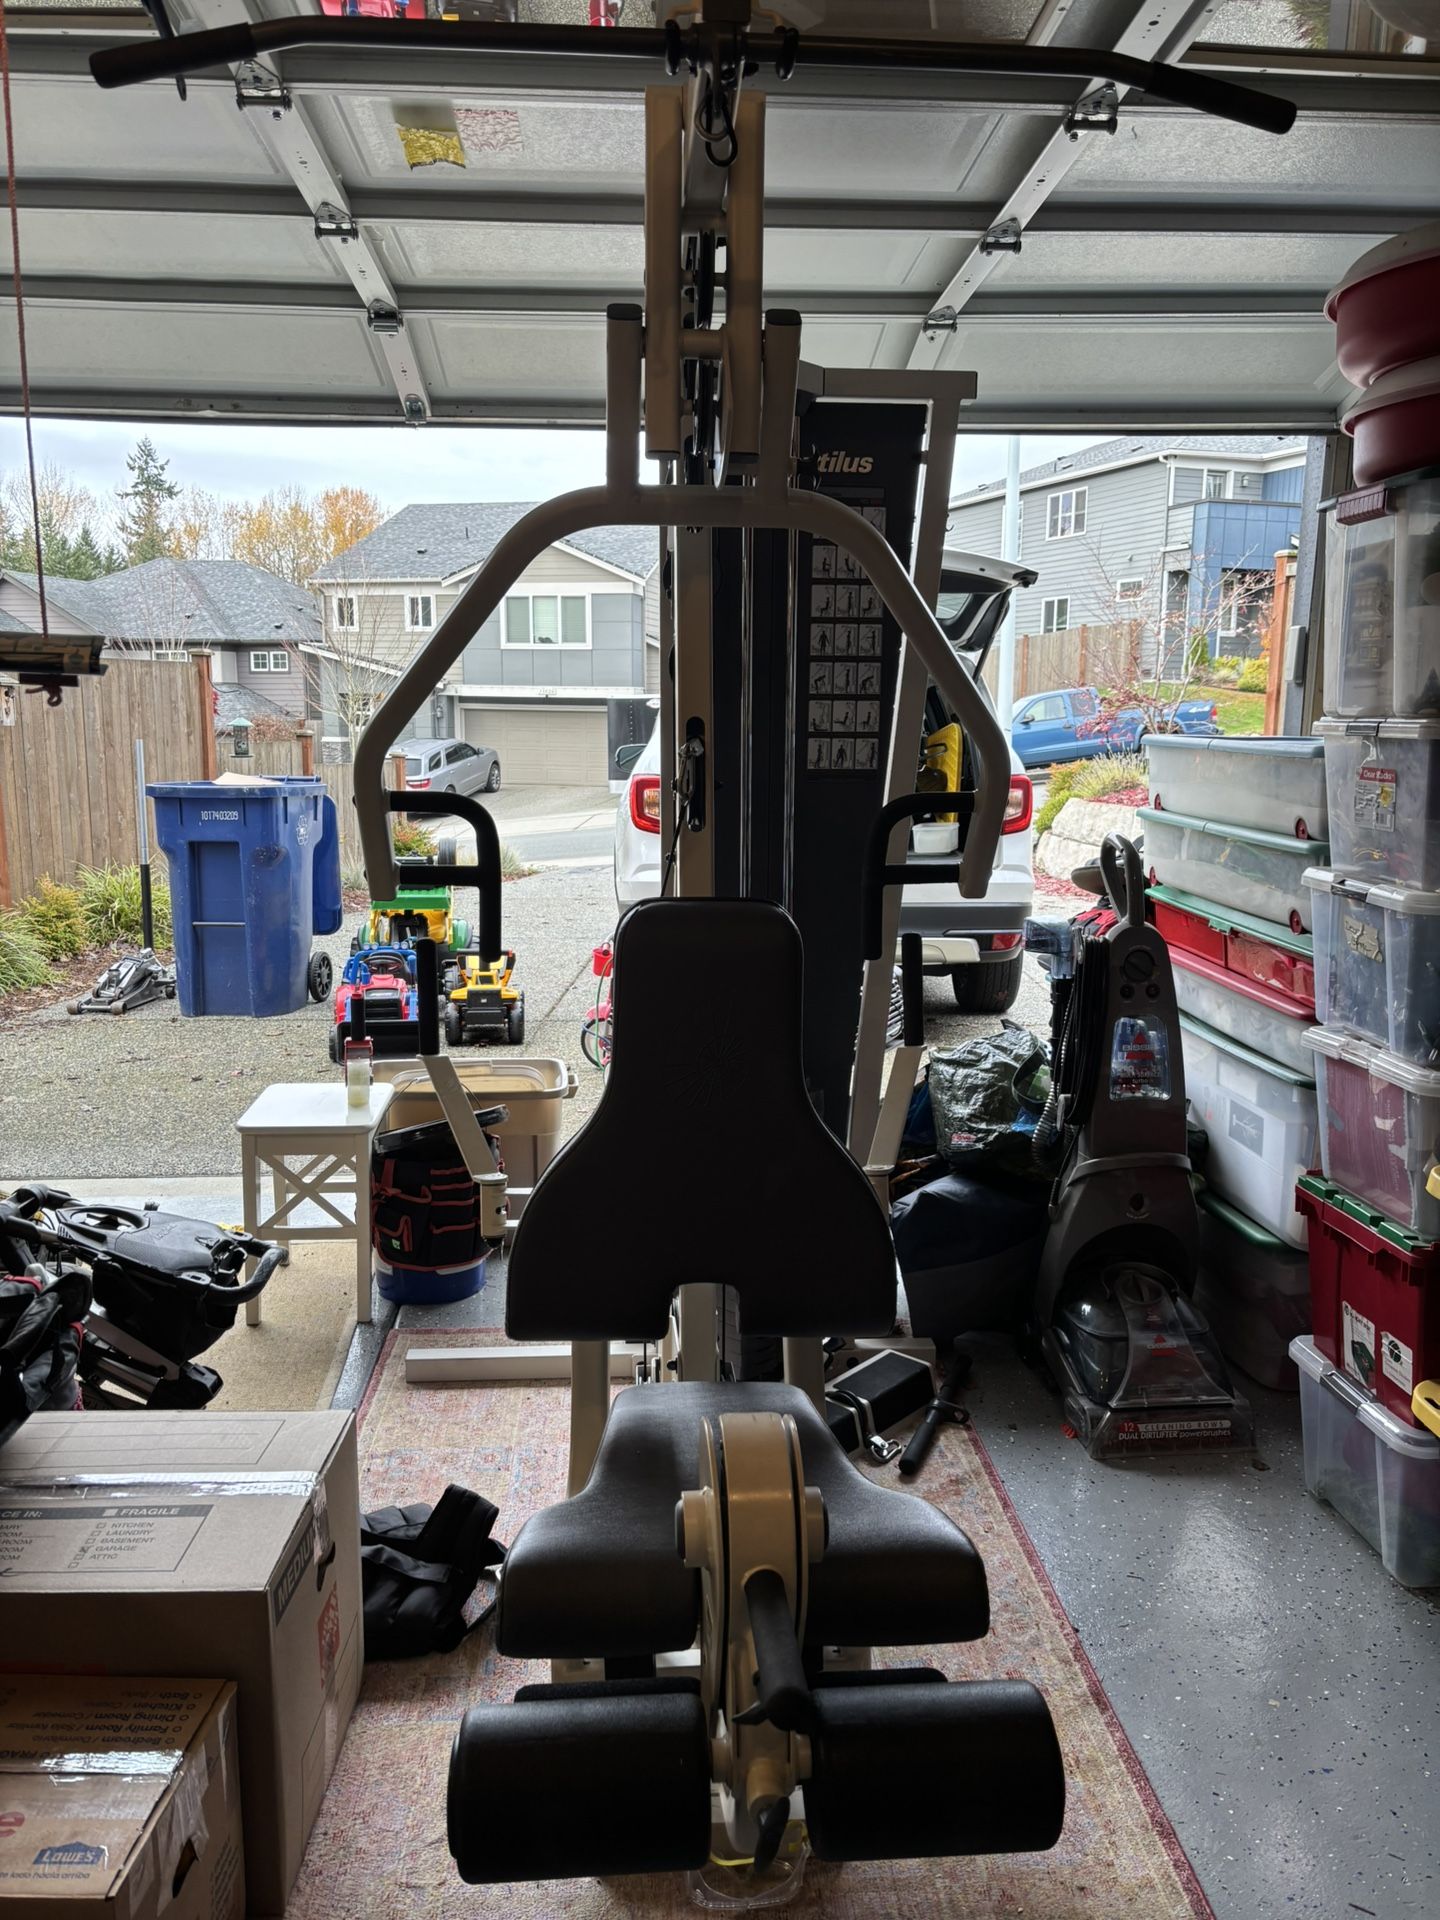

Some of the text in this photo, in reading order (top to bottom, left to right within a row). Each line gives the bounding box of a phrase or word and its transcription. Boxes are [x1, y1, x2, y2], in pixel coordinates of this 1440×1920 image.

[818, 451, 874, 473] tilus
[1123, 1420, 1225, 1432] 12 CLEANING ROWS
[1119, 1429, 1231, 1440] DUAL DIRTLIFTER powerbrushes
[23, 1510, 42, 1518] IN:
[120, 1507, 180, 1516] FRAGILE
[132, 1702, 184, 1711] Kitchen
[95, 1712, 131, 1721] Room
[133, 1711, 177, 1722] Dining
[86, 1723, 123, 1733] Room
[125, 1723, 169, 1733] Family
[102, 1735, 162, 1745] Bedroom
[0, 1749, 38, 1759] FRAG
